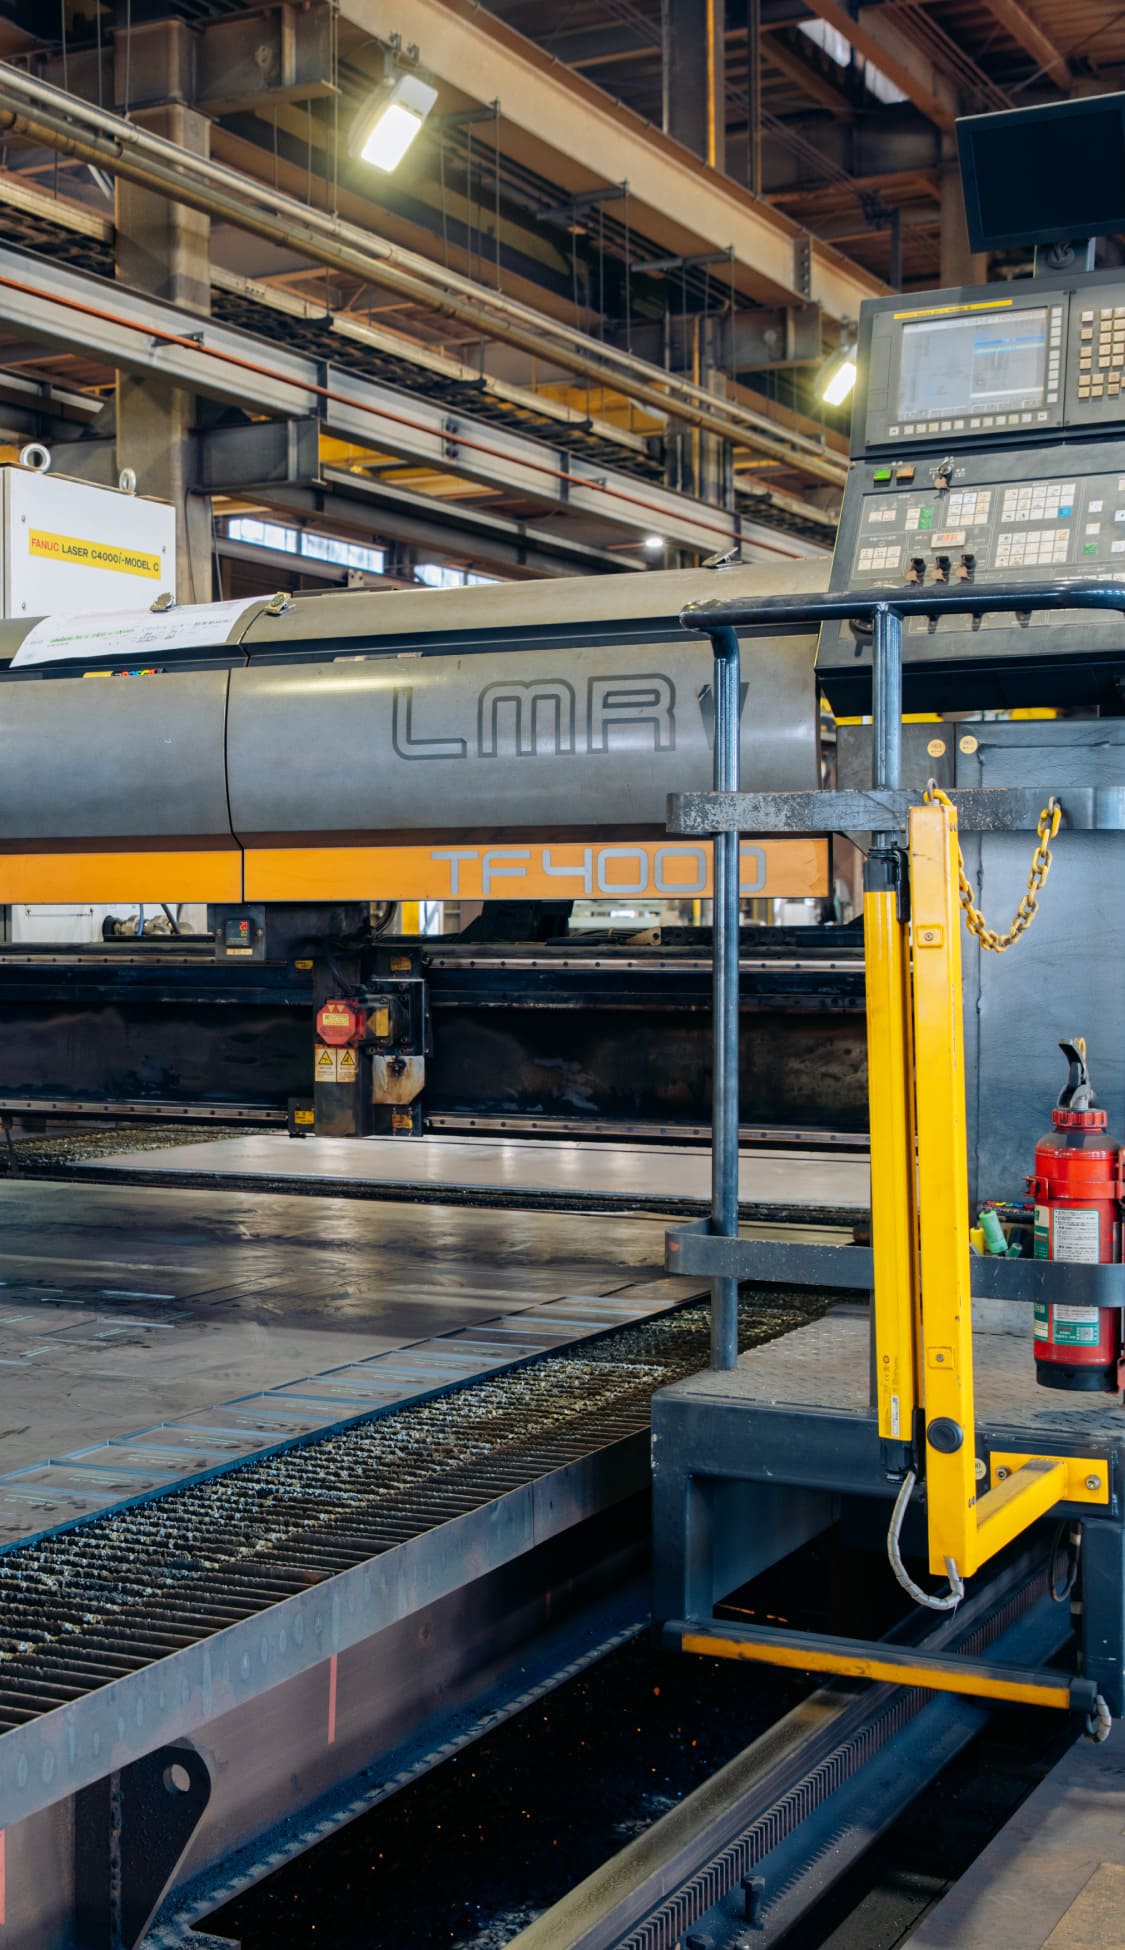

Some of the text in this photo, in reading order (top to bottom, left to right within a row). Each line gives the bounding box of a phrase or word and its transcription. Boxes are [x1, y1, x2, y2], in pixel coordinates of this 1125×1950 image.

[31, 538, 59, 551] FANUC
[62, 544, 88, 557] LASER
[153, 562, 159, 571] C
